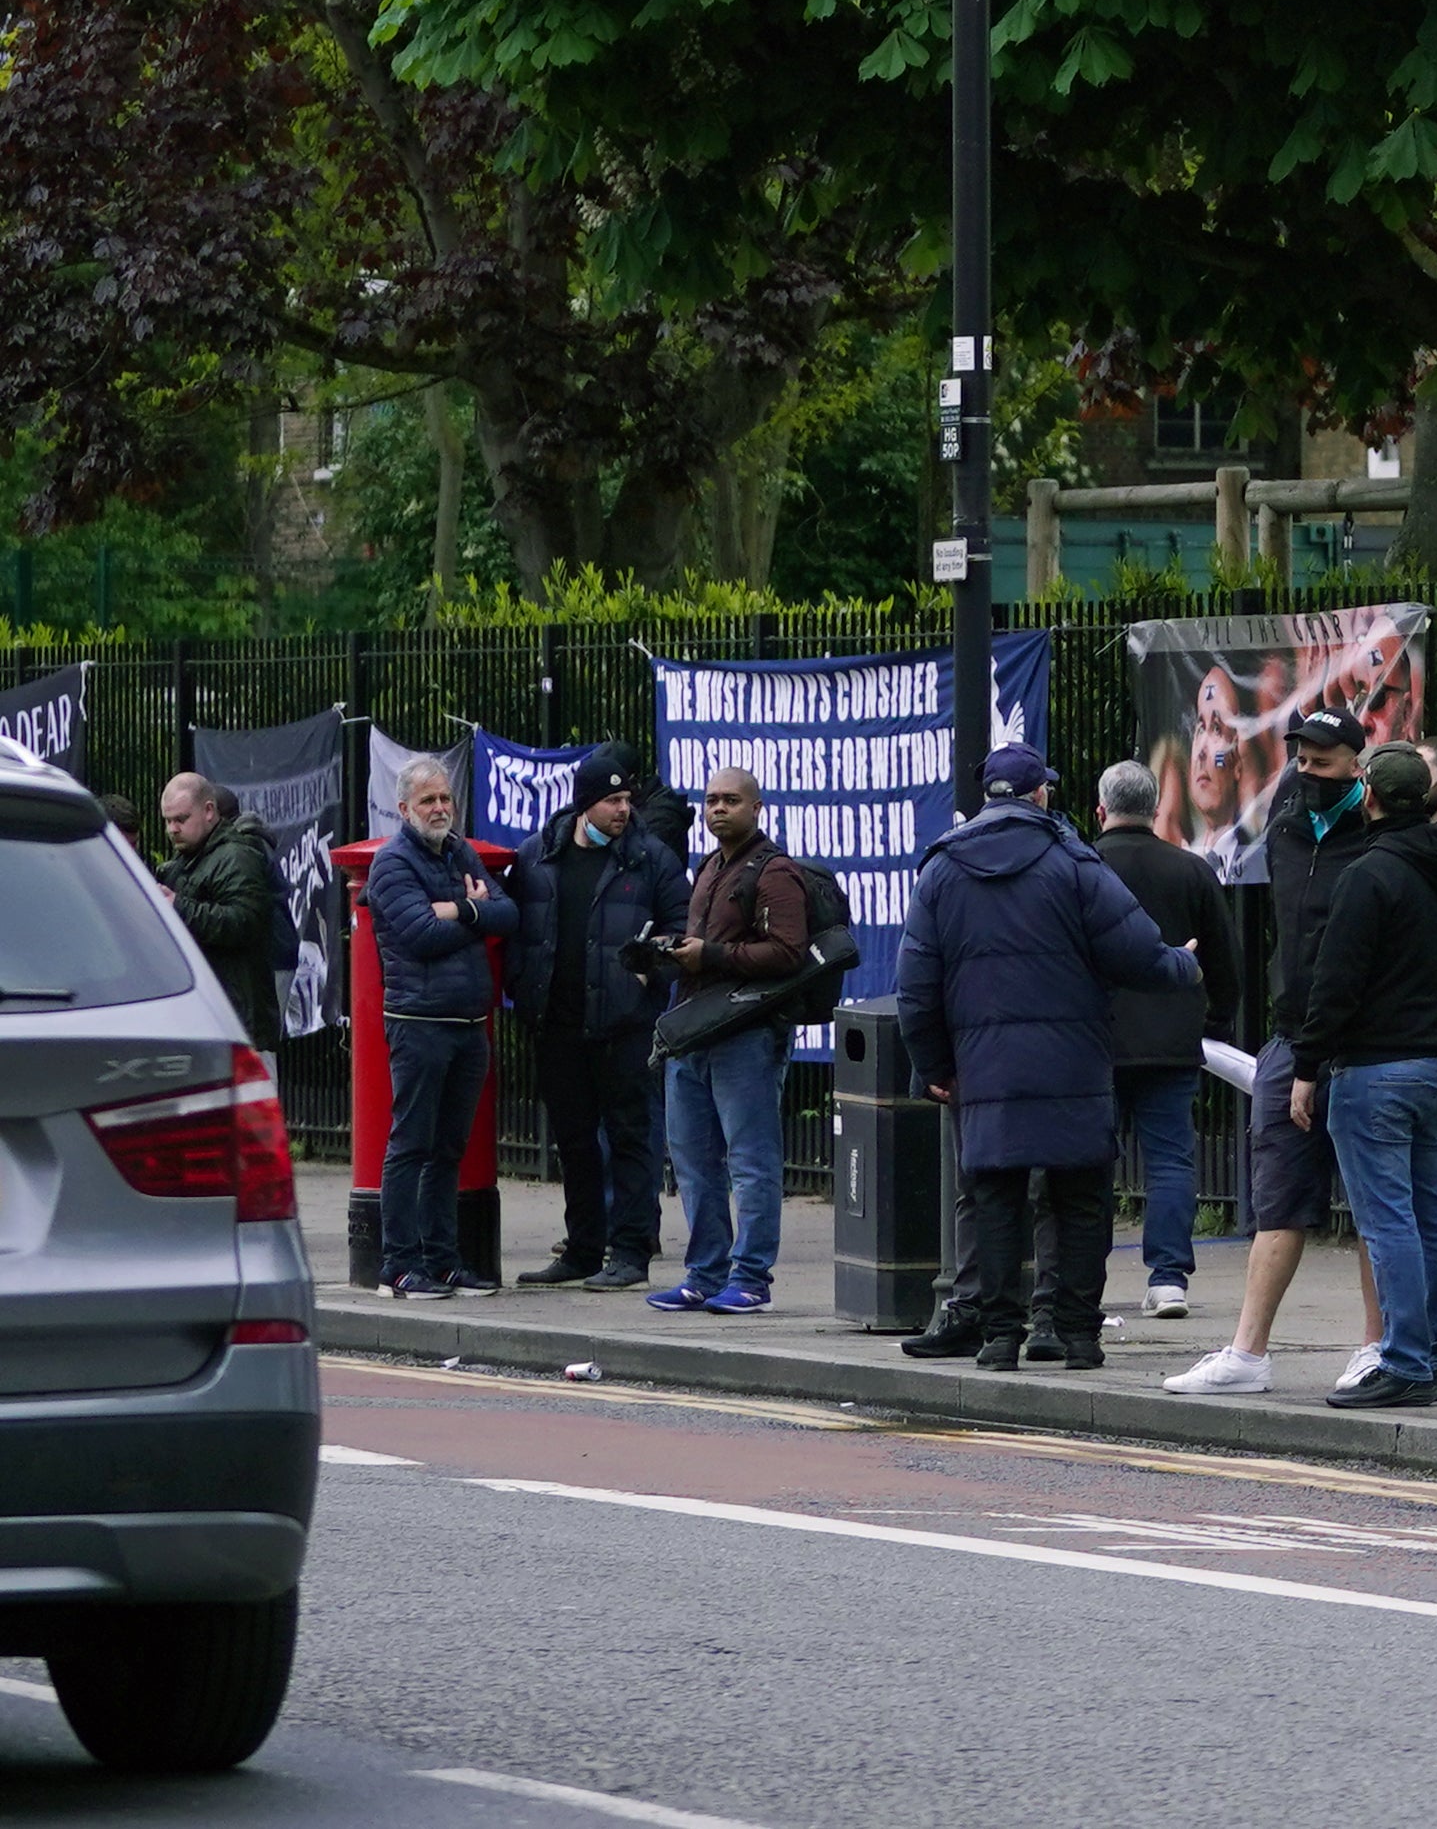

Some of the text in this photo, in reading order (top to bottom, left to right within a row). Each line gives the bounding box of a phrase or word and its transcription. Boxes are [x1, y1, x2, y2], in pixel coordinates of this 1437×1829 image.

[694, 670, 748, 723] MUST
[749, 671, 832, 724] ALWAYS
[834, 661, 939, 722] CONSIDER
[669, 737, 706, 791] OUR
[831, 736, 867, 791] FOR
[868, 727, 956, 790] WITHOU
[785, 803, 856, 859] WOULD
[858, 802, 885, 859] BE
[888, 799, 916, 857] NO
[96, 1054, 192, 1083] X3
